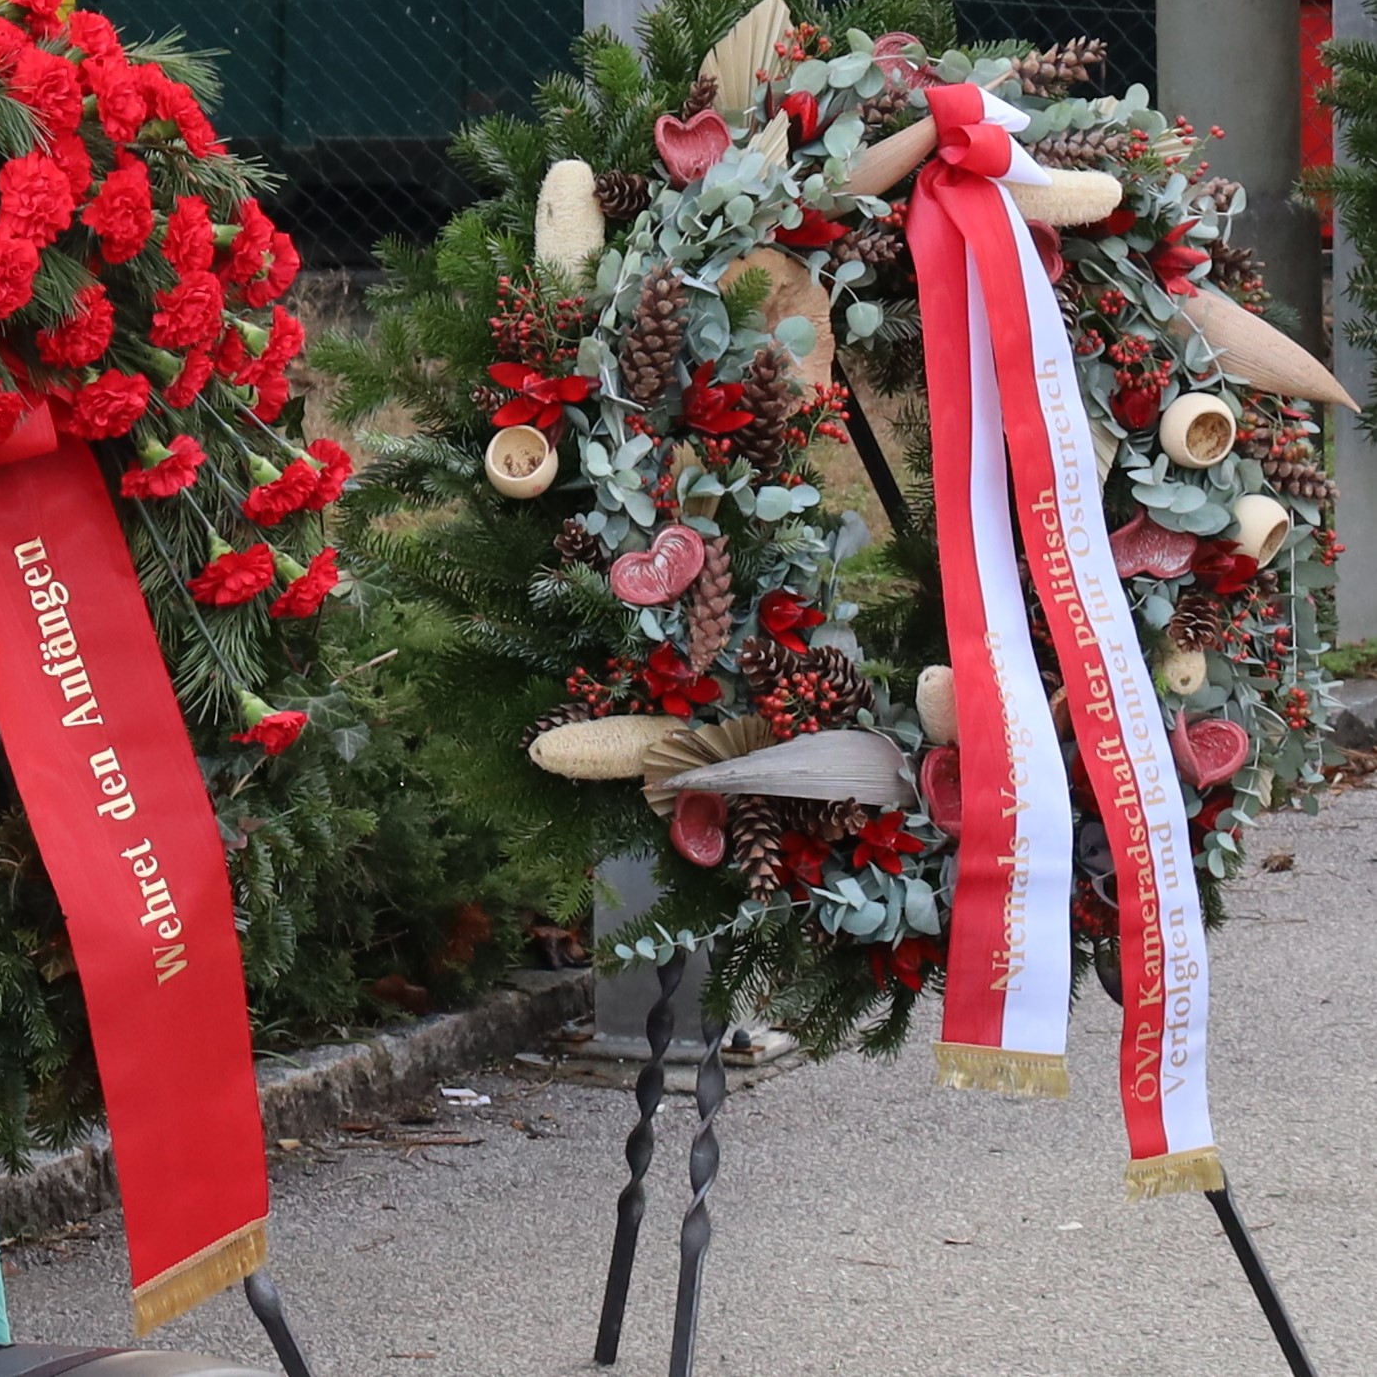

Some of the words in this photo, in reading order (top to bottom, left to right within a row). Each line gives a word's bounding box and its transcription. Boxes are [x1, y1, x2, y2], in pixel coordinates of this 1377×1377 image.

[13, 535, 105, 728] Anfängen
[1031, 485, 1102, 649] politisch
[1083, 573, 1115, 626] für
[984, 630, 1034, 820] Vergessen
[1086, 662, 1114, 723] der
[1108, 640, 1168, 808] Bekenner
[88, 746, 137, 821] den
[1150, 820, 1180, 891] und
[120, 837, 189, 986] Wehret
[990, 835, 1030, 993] Niemals
[1095, 734, 1163, 1009] Kameradschaft
[1131, 1020, 1161, 1103] ÖVP
[1164, 904, 1200, 1097] Verfolgten
